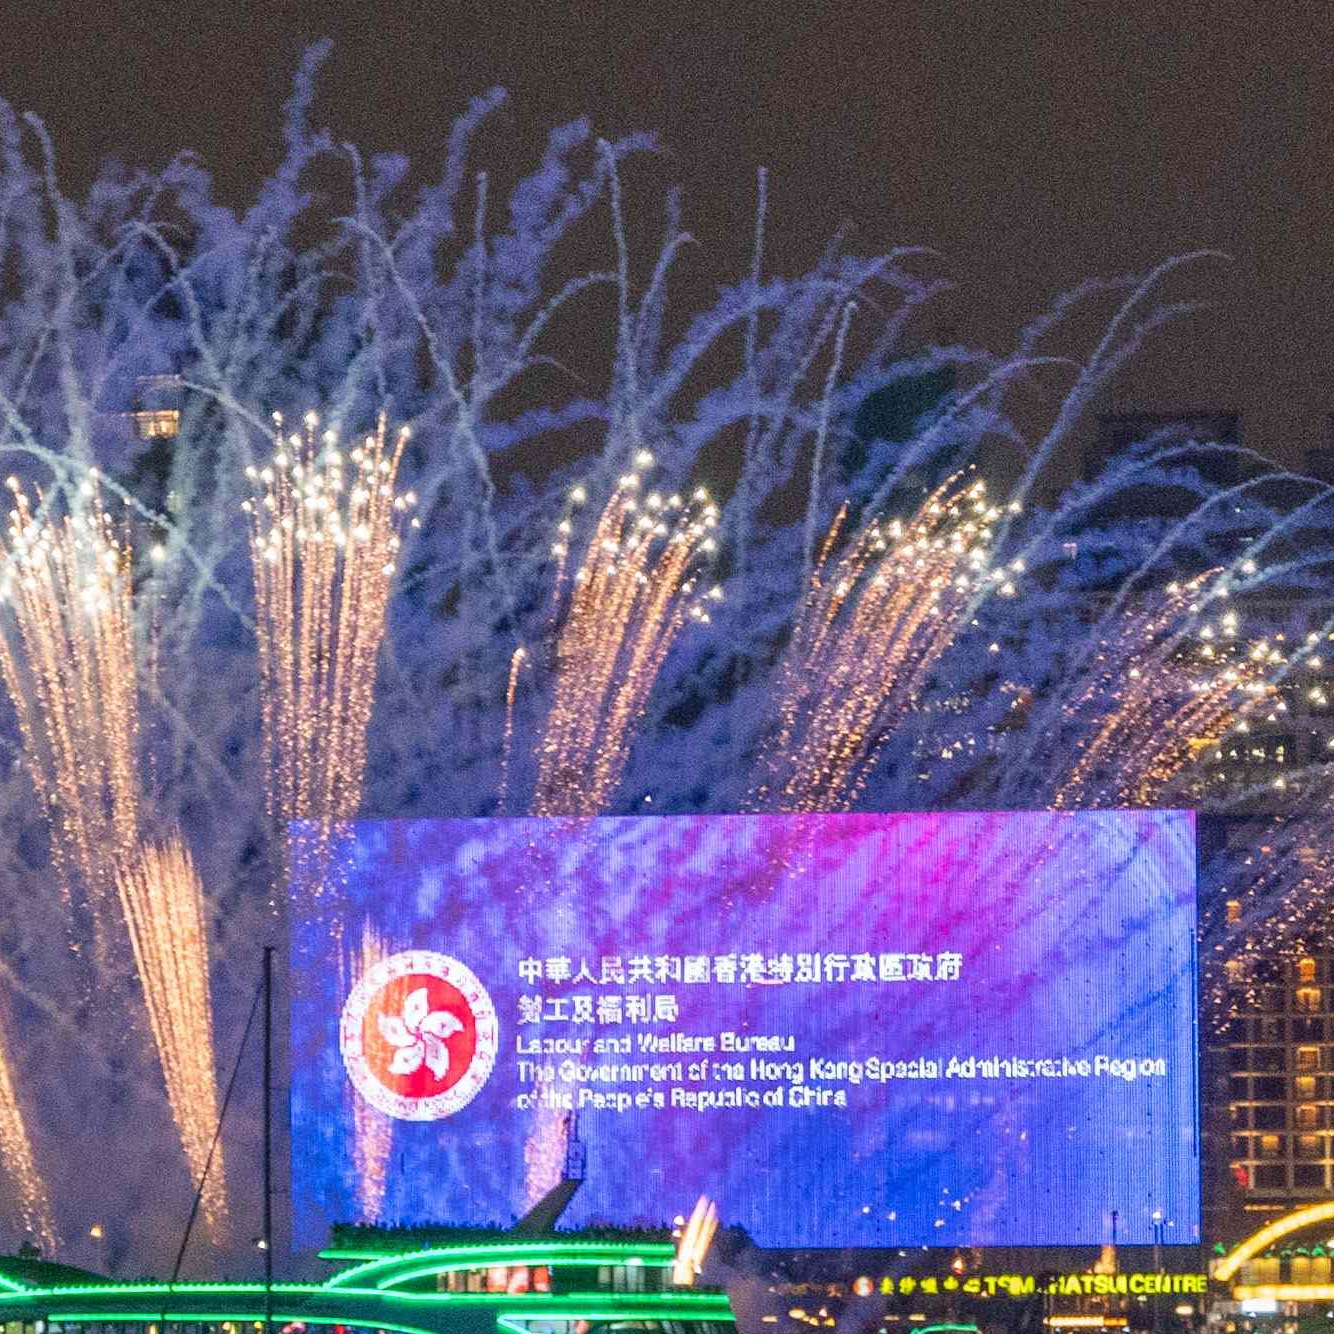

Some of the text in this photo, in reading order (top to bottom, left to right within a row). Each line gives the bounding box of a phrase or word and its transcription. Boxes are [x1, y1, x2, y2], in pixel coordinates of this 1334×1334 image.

[720, 1031, 796, 1052] Bureau
[750, 1058, 805, 1085] Hong
[1094, 1055, 1167, 1082] Regon
[578, 1087, 665, 1113] Peope's
[1129, 1273, 1207, 1293] CENTRE
